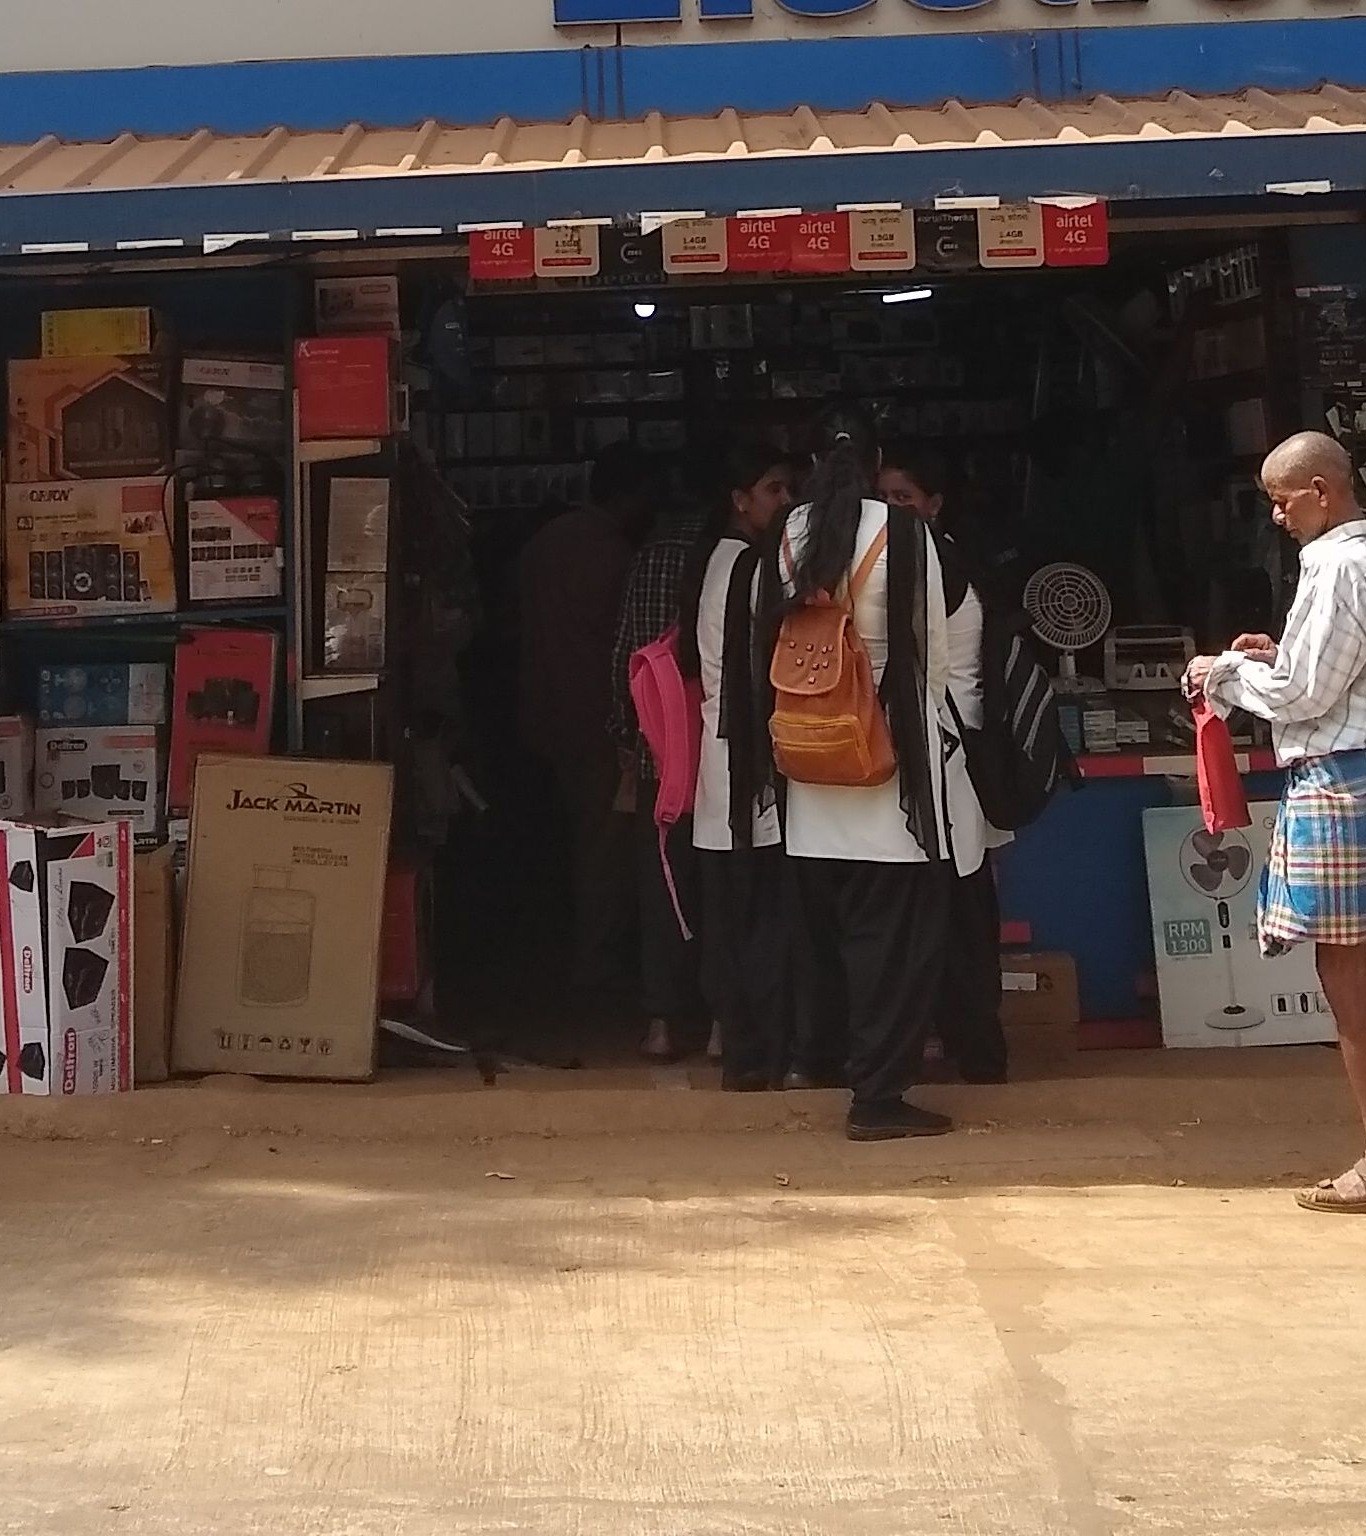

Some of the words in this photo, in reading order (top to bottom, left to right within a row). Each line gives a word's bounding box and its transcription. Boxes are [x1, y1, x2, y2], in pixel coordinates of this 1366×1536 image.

[739, 219, 777, 234] airtel
[799, 221, 836, 235] airtel
[1056, 213, 1093, 228] airtel
[483, 227, 521, 241] airtel
[1064, 230, 1087, 244] 4G
[491, 243, 514, 257] 4G
[747, 235, 771, 250] 4G
[807, 236, 830, 250] 4G
[226, 789, 280, 811] JACK
[284, 799, 361, 816] MARTIN
[1168, 922, 1205, 938] RPM
[1170, 937, 1208, 953] 1300
[64, 1030, 76, 1091] Deltron
